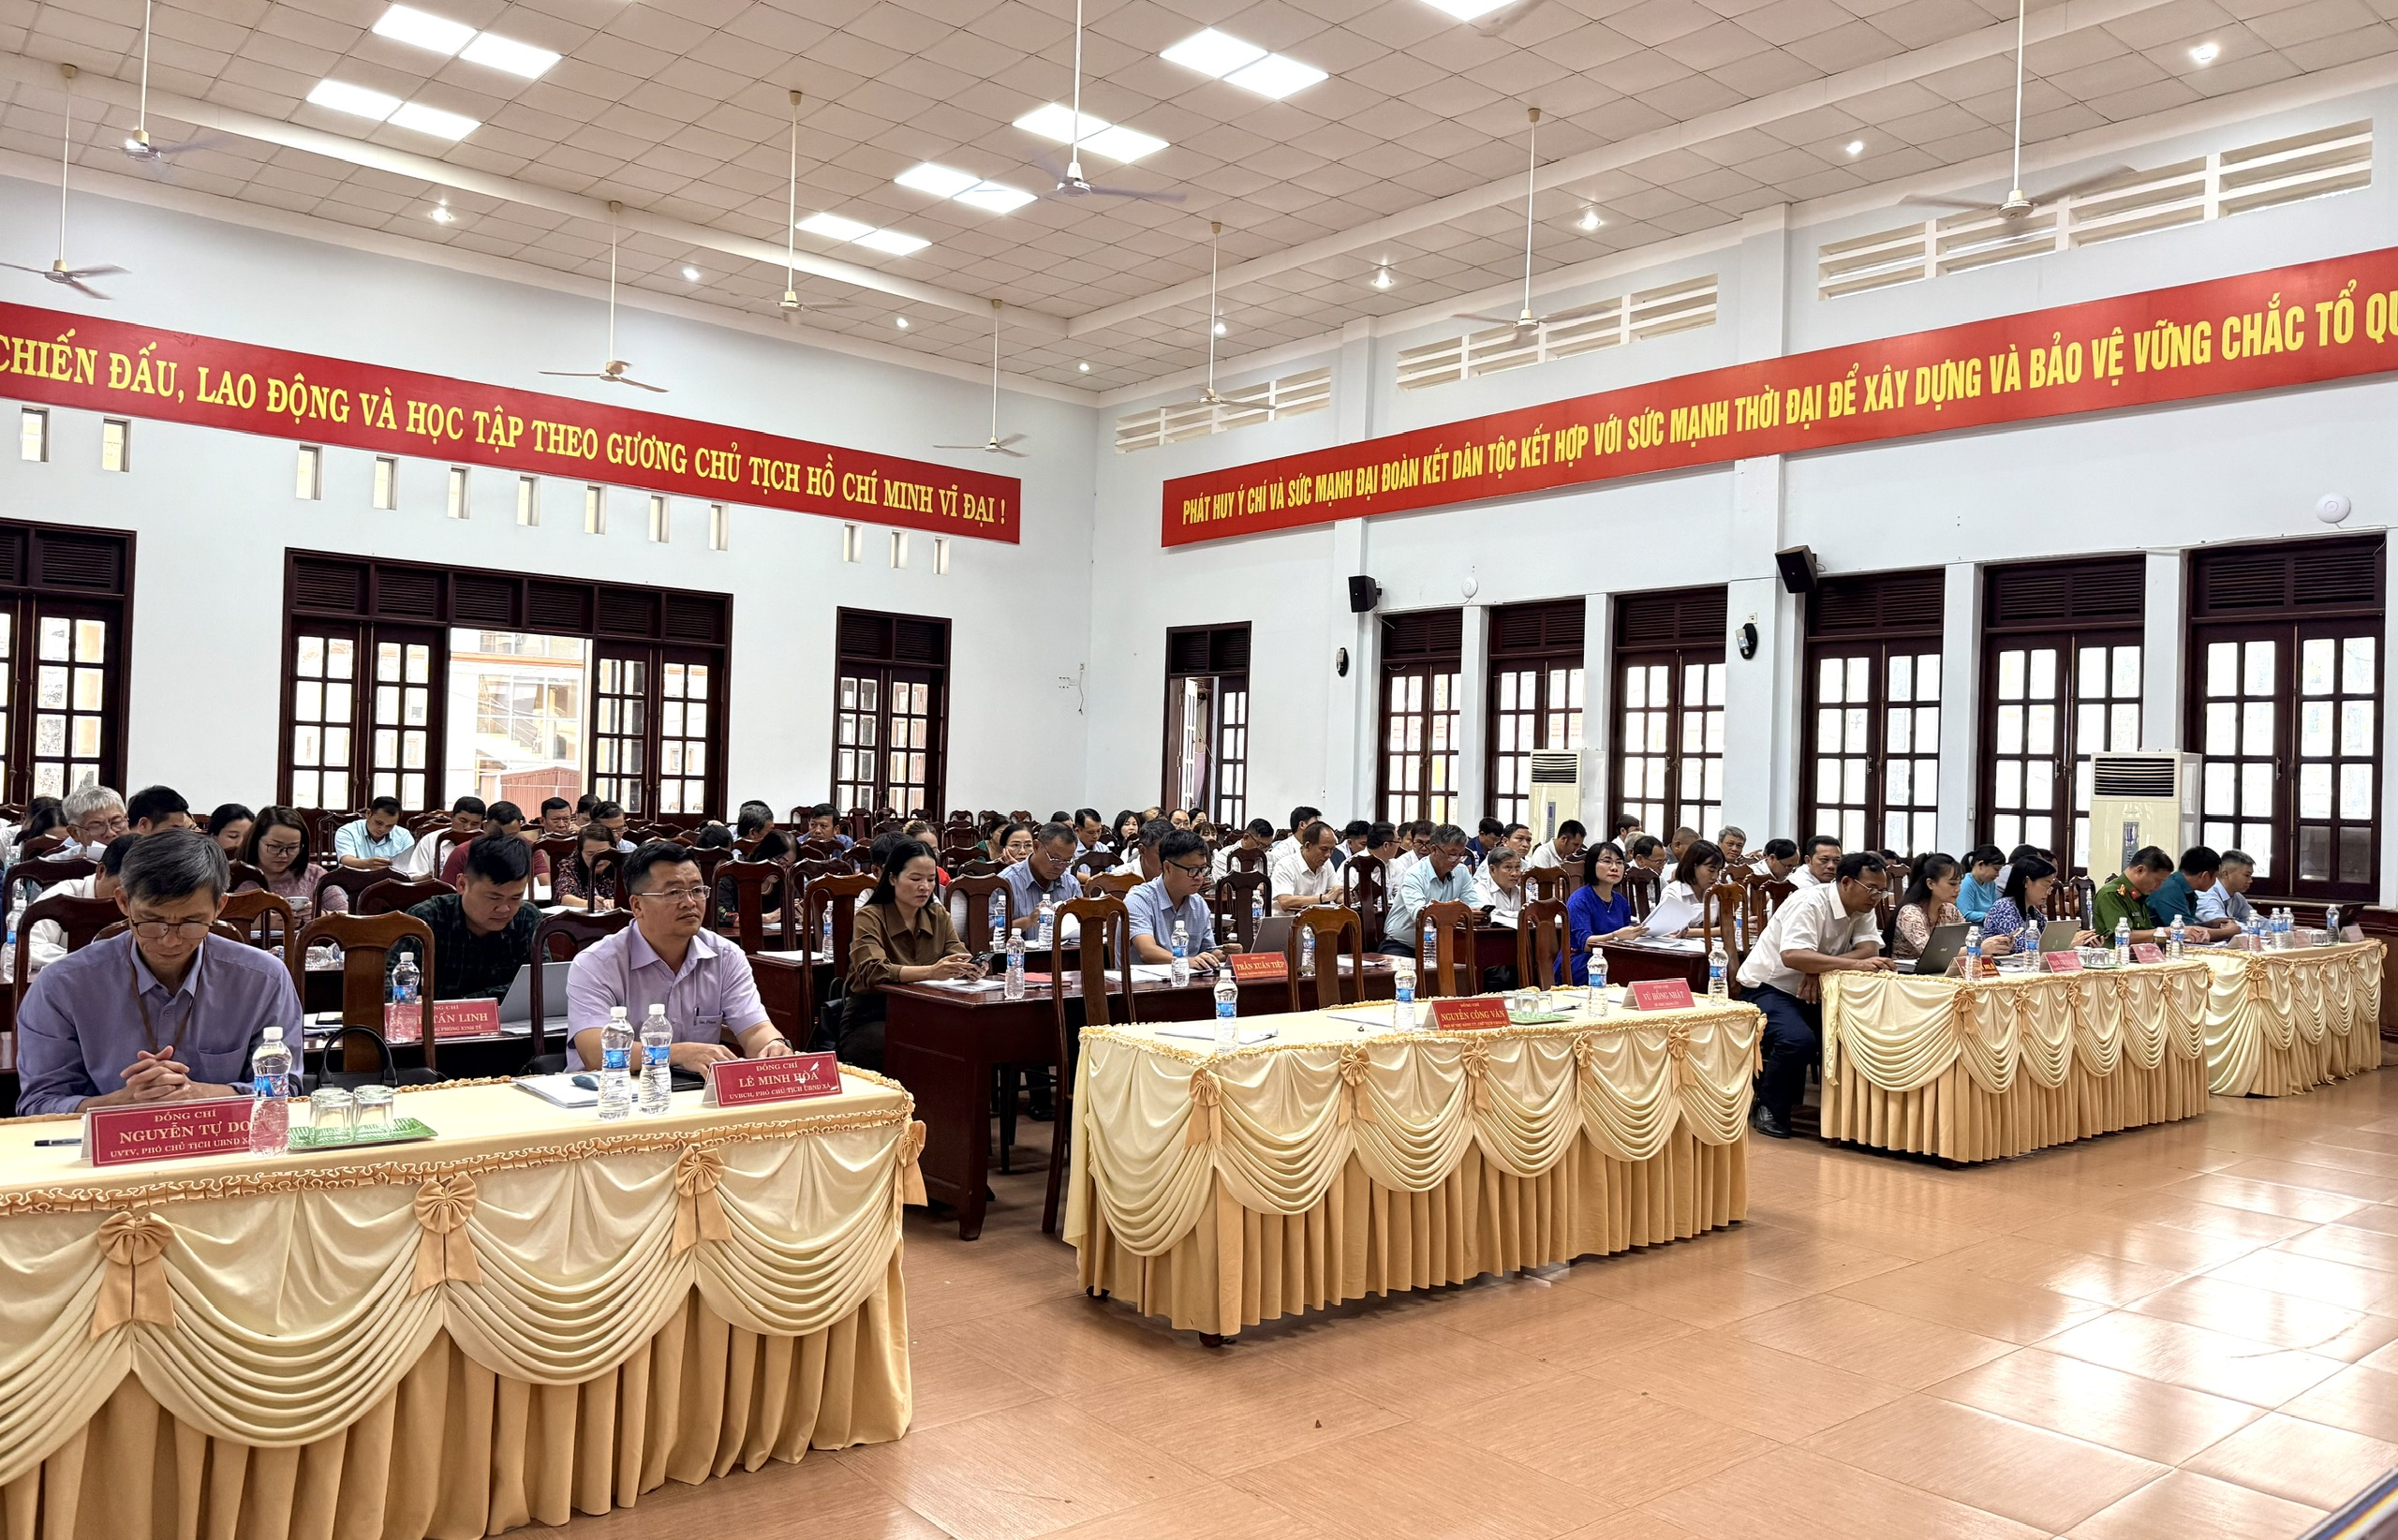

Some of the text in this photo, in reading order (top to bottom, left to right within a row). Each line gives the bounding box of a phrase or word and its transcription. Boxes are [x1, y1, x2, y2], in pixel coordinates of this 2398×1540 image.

[1182, 492, 1212, 526] PHÁT
[1212, 490, 1236, 520] HUY
[1236, 481, 1247, 515] Ý
[1247, 481, 1268, 514] CHÍ
[1269, 478, 1286, 511] VÀ
[1287, 471, 1313, 510] SỨC
[1314, 470, 1354, 508] MẠNH
[1355, 464, 1380, 506] ĐẠI
[1381, 456, 1420, 493] ĐOÀN
[1422, 441, 1451, 485] KẾT
[1452, 445, 1485, 481] DÂN
[1487, 436, 1517, 481] TỘC
[1519, 422, 1551, 469] KẾT
[1554, 424, 1590, 468] HỢP
[1593, 409, 1622, 456] VỚI
[1626, 405, 1665, 452] SỨC
[1669, 399, 1729, 449] MẠNH
[1734, 383, 1781, 432] THỜI
[1785, 384, 1823, 431] ĐẠI
[1828, 362, 1860, 419] ĐỂ
[1862, 364, 1909, 413] XÂY
[1915, 357, 1982, 412] DỰNG
[1989, 343, 2022, 394] VÀ
[2029, 331, 2083, 390] BẢO
[2091, 326, 2125, 387] VỆ
[2133, 318, 2213, 374] VỮNG
[2221, 291, 2305, 362] CHẮC
[2315, 278, 2358, 348] TỔ
[108, 342, 185, 404] ĐẤU,
[197, 366, 257, 410] LAO
[266, 372, 350, 425] ĐỘNG
[359, 387, 398, 430] VÀ
[406, 399, 465, 445] HỌC
[472, 404, 525, 453] TẬP
[531, 420, 600, 462] THEO
[606, 432, 688, 475] GƯƠNG
[694, 441, 743, 482] CHỦ
[748, 456, 801, 496] TỊCH
[807, 453, 836, 499] HỒ
[842, 469, 878, 506] CHÍ
[883, 479, 935, 515] MINH
[939, 482, 959, 518] VĨ
[963, 491, 996, 529] ĐẠI
[999, 497, 1007, 525] !
[459, 1013, 488, 1023] LINH
[1440, 1009, 1470, 1021] NGUYỄN
[1470, 1009, 1489, 1019] CÔNG
[756, 1063, 780, 1072] ĐỒNG
[739, 1070, 820, 1088] LÊ MINH HÒA
[155, 1108, 216, 1122] ĐỒNG CHÍ
[119, 1121, 194, 1144] NGUYỄN
[199, 1120, 223, 1138] TỰ
[110, 1148, 140, 1158] UVTV,
[141, 1146, 162, 1155] PHÓ
[164, 1141, 185, 1151] CHỦ
[187, 1141, 211, 1150] TỊCH
[214, 1137, 241, 1147] UBND
